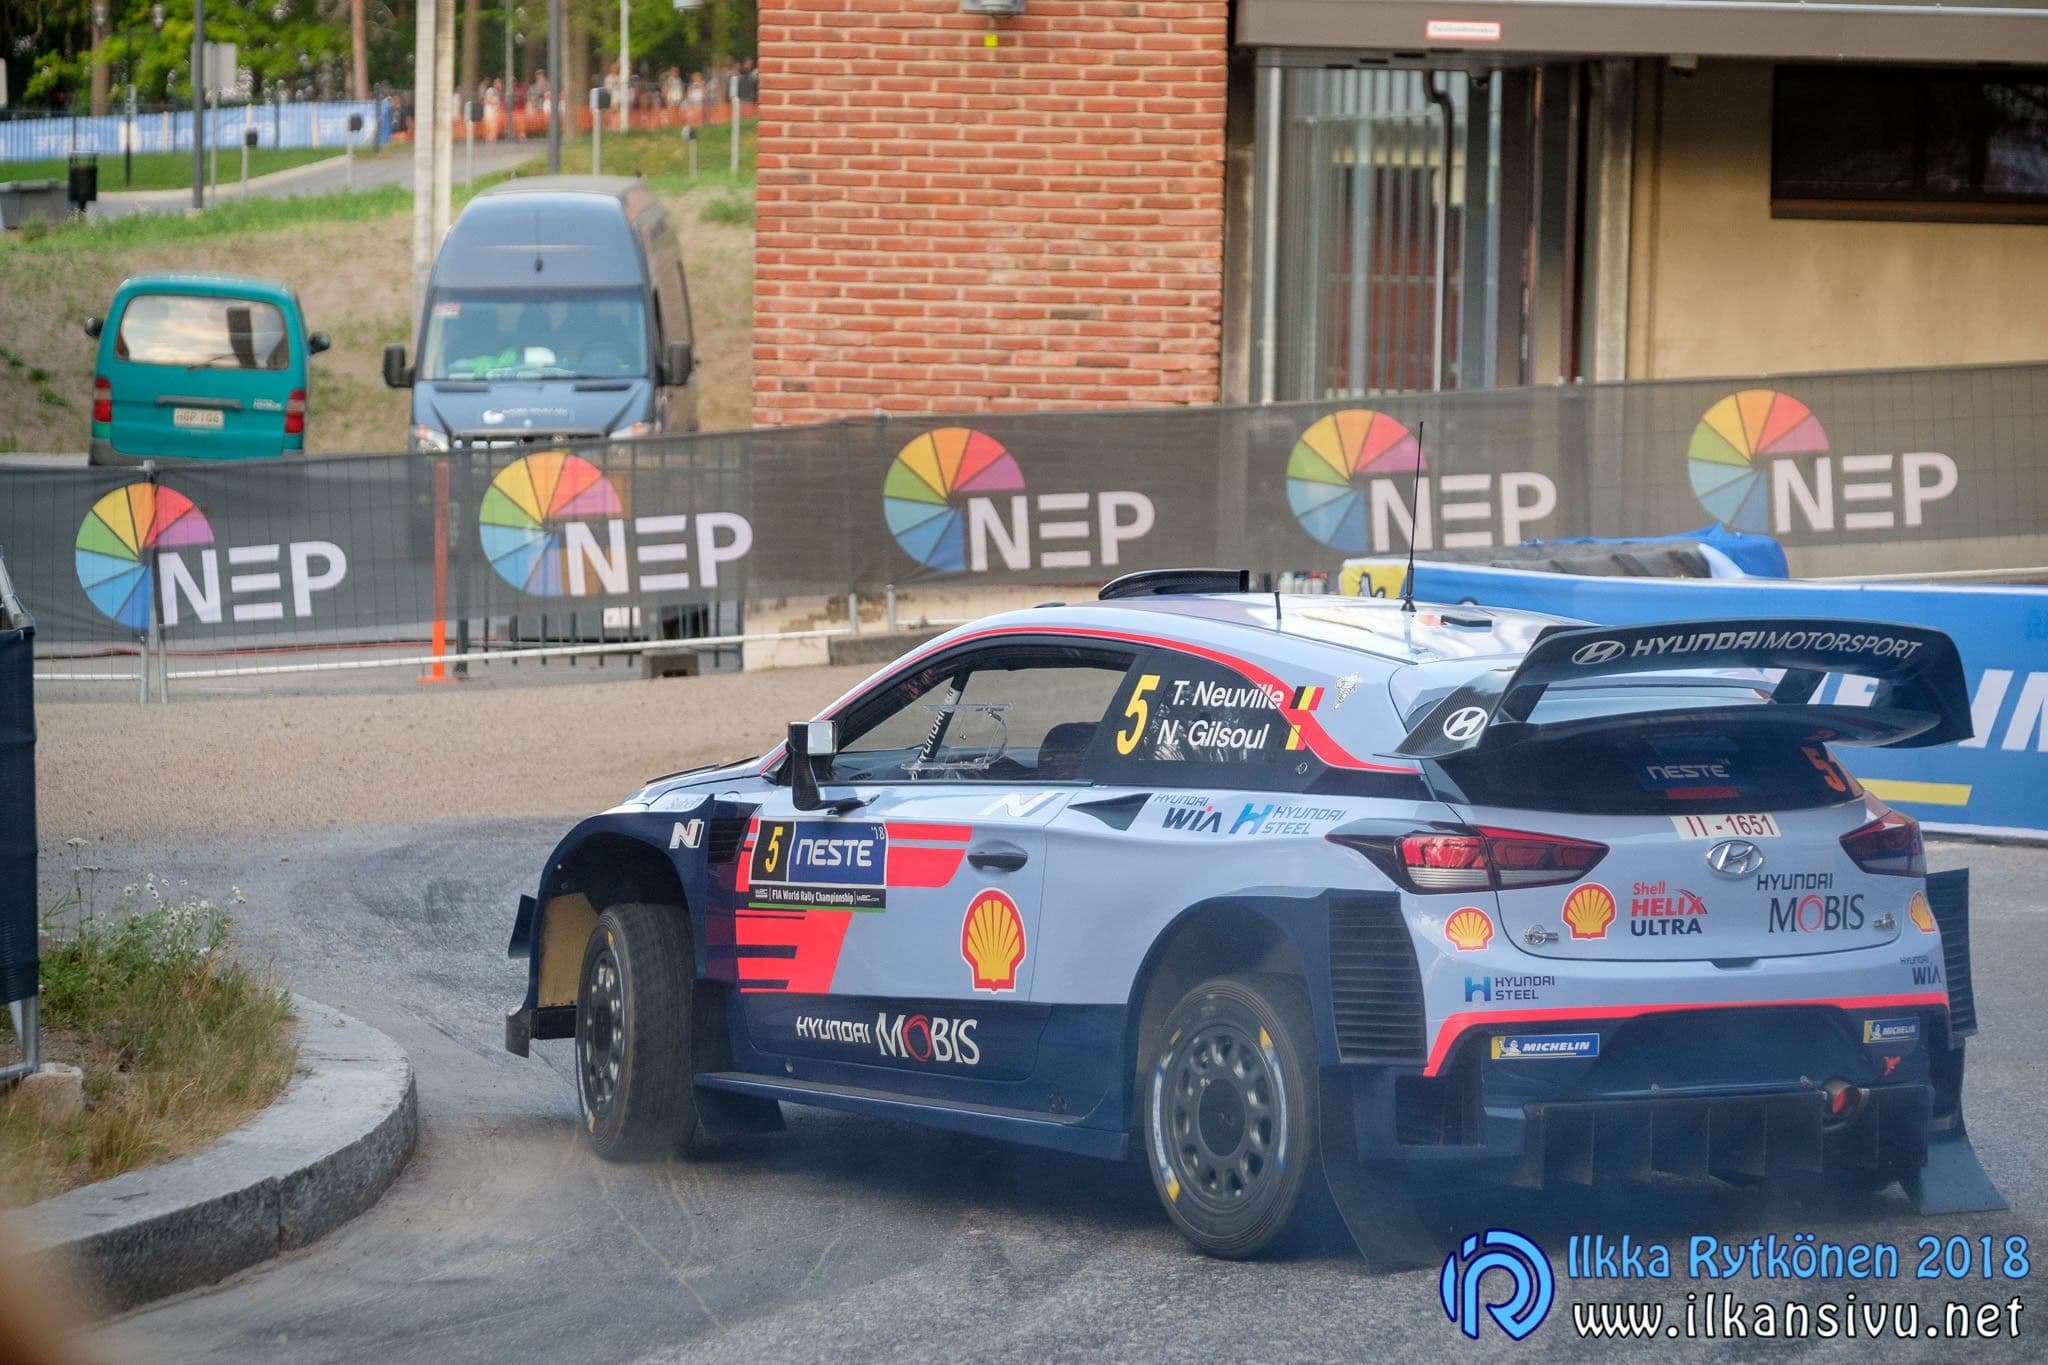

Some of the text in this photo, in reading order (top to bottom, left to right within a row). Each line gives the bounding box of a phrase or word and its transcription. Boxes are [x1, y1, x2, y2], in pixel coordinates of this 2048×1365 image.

[1772, 452, 1958, 533] NEP
[1371, 472, 1557, 554] NEP
[967, 491, 1156, 572] NEP
[563, 512, 753, 598] NEP
[156, 541, 347, 627] NEP
[1762, 631, 1923, 660] MOTORSPORT
[1172, 680, 1285, 710] T. Neuville
[1116, 674, 1161, 756] 5
[1157, 720, 1271, 750] N. Gilsoul
[1646, 764, 1730, 780] NESTE
[1154, 793, 1211, 806] HYUNDAI
[1272, 806, 1347, 821] HYUNDAI
[1162, 805, 1222, 833] WIA
[1261, 821, 1312, 835] STEEL
[765, 826, 784, 873] 5
[795, 838, 874, 867] NESTE
[1633, 880, 1666, 896] Shell
[1756, 873, 1834, 891] HYUNDAI
[772, 889, 783, 901] FIA
[783, 889, 800, 901] World
[800, 890, 815, 904] Rally
[815, 891, 854, 905] Championship
[1631, 892, 1707, 917] HELIX
[1768, 892, 1865, 933] MOBIS
[1631, 918, 1703, 937] ULTRA
[1495, 976, 1555, 987] HYUNDAI
[1911, 963, 1942, 985] WIA
[1495, 989, 1539, 1001] STEEL
[795, 1012, 981, 1065] HYUNDAI MOBIS
[1522, 1041, 1590, 1053] MICHELIN
